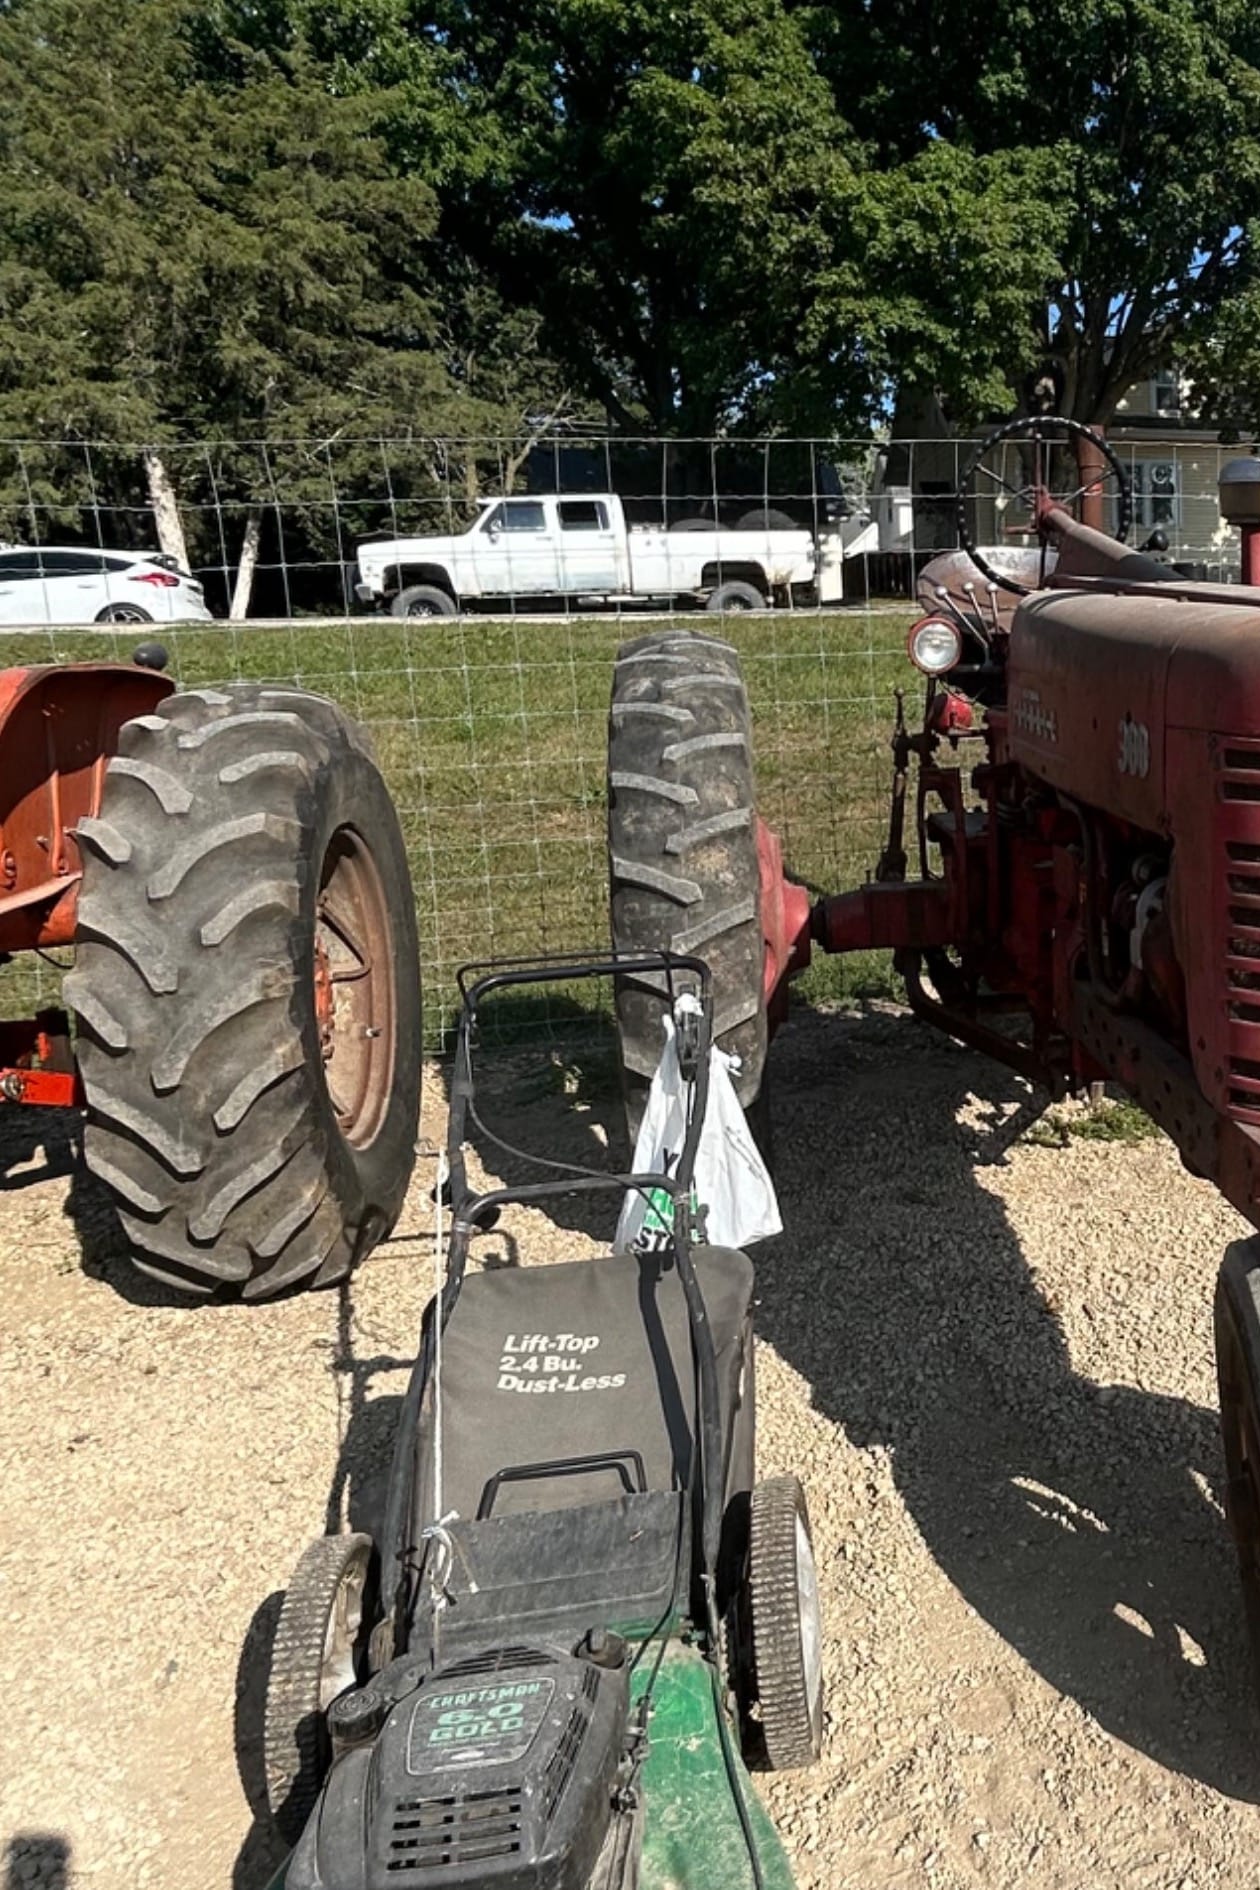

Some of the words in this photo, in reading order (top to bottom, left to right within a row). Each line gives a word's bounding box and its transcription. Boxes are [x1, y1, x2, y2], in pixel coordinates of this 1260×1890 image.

[503, 1333, 600, 1355] Lift-Top
[498, 1354, 539, 1373] 2.4
[542, 1354, 582, 1373] Bu.
[497, 1373, 627, 1393] Dust-Less
[430, 1682, 541, 1709] CRAFTSMAN
[429, 1717, 524, 1742] GOLD
